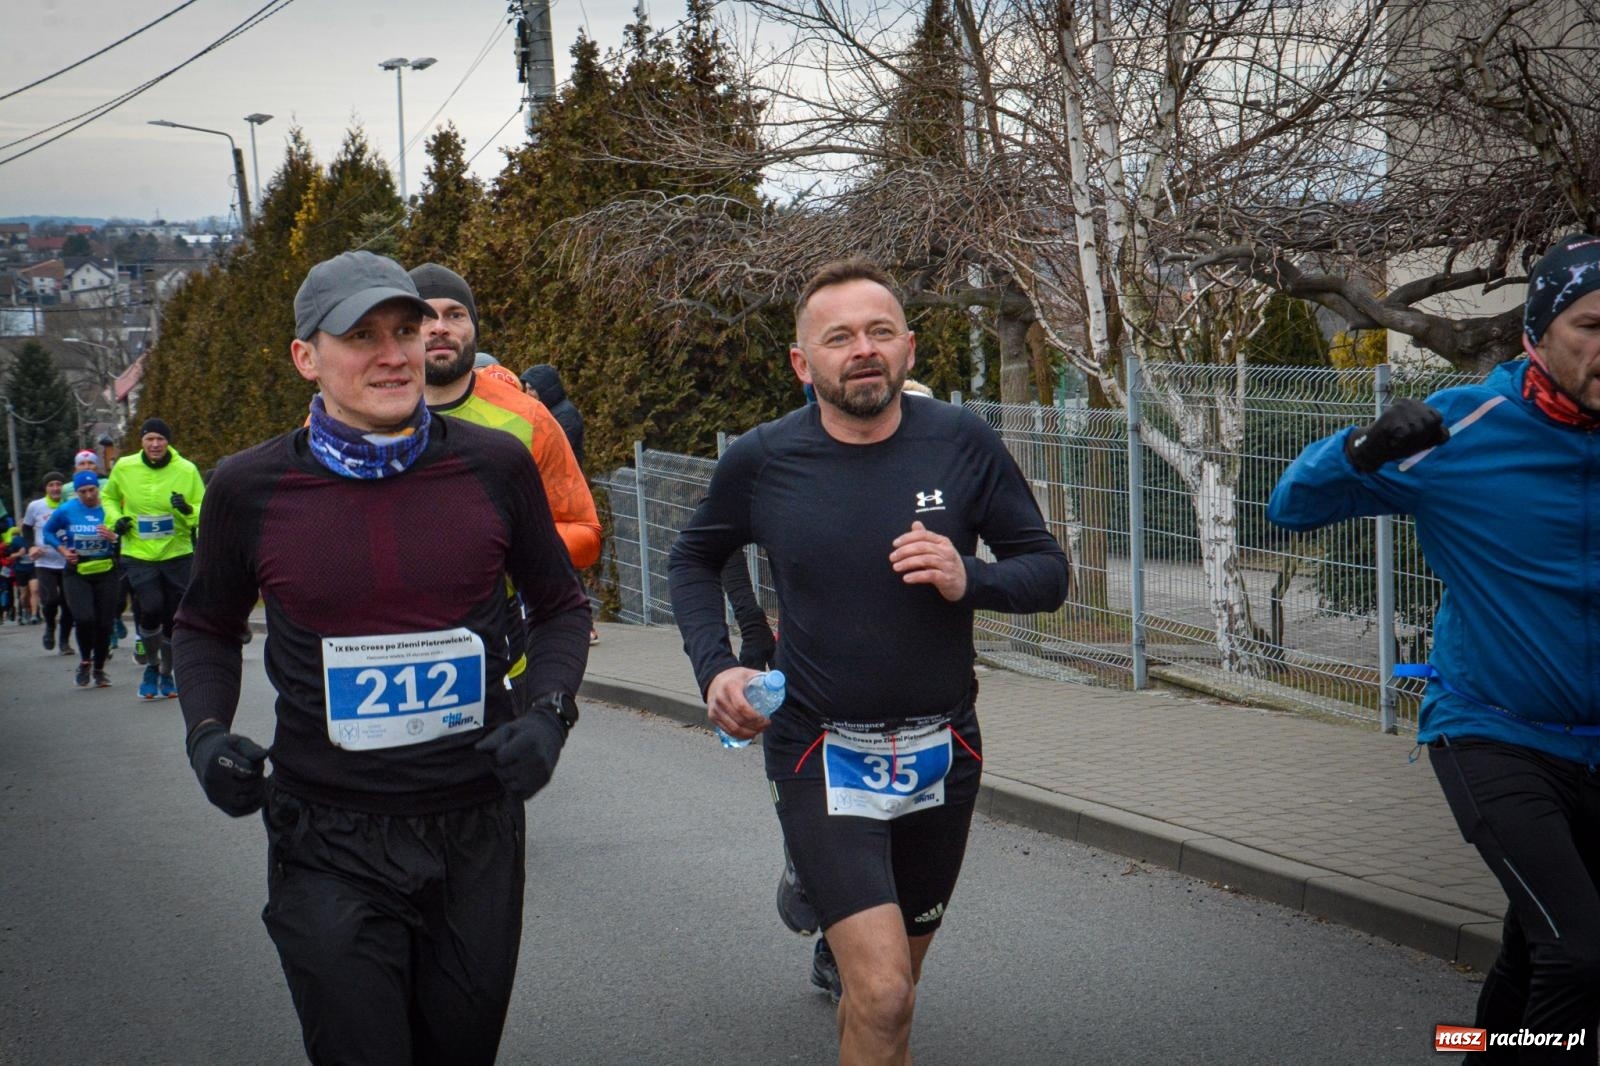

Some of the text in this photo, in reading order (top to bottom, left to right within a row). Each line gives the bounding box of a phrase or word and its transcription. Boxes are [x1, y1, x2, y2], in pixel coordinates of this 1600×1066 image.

[152, 522, 160, 532] 5
[345, 645, 360, 653] Eko
[361, 644, 385, 652] Cross
[386, 644, 396, 652] po
[397, 640, 421, 650] Ziemi
[421, 635, 473, 648] Pietrowickiej
[356, 662, 459, 715] 212
[862, 755, 919, 793] 35
